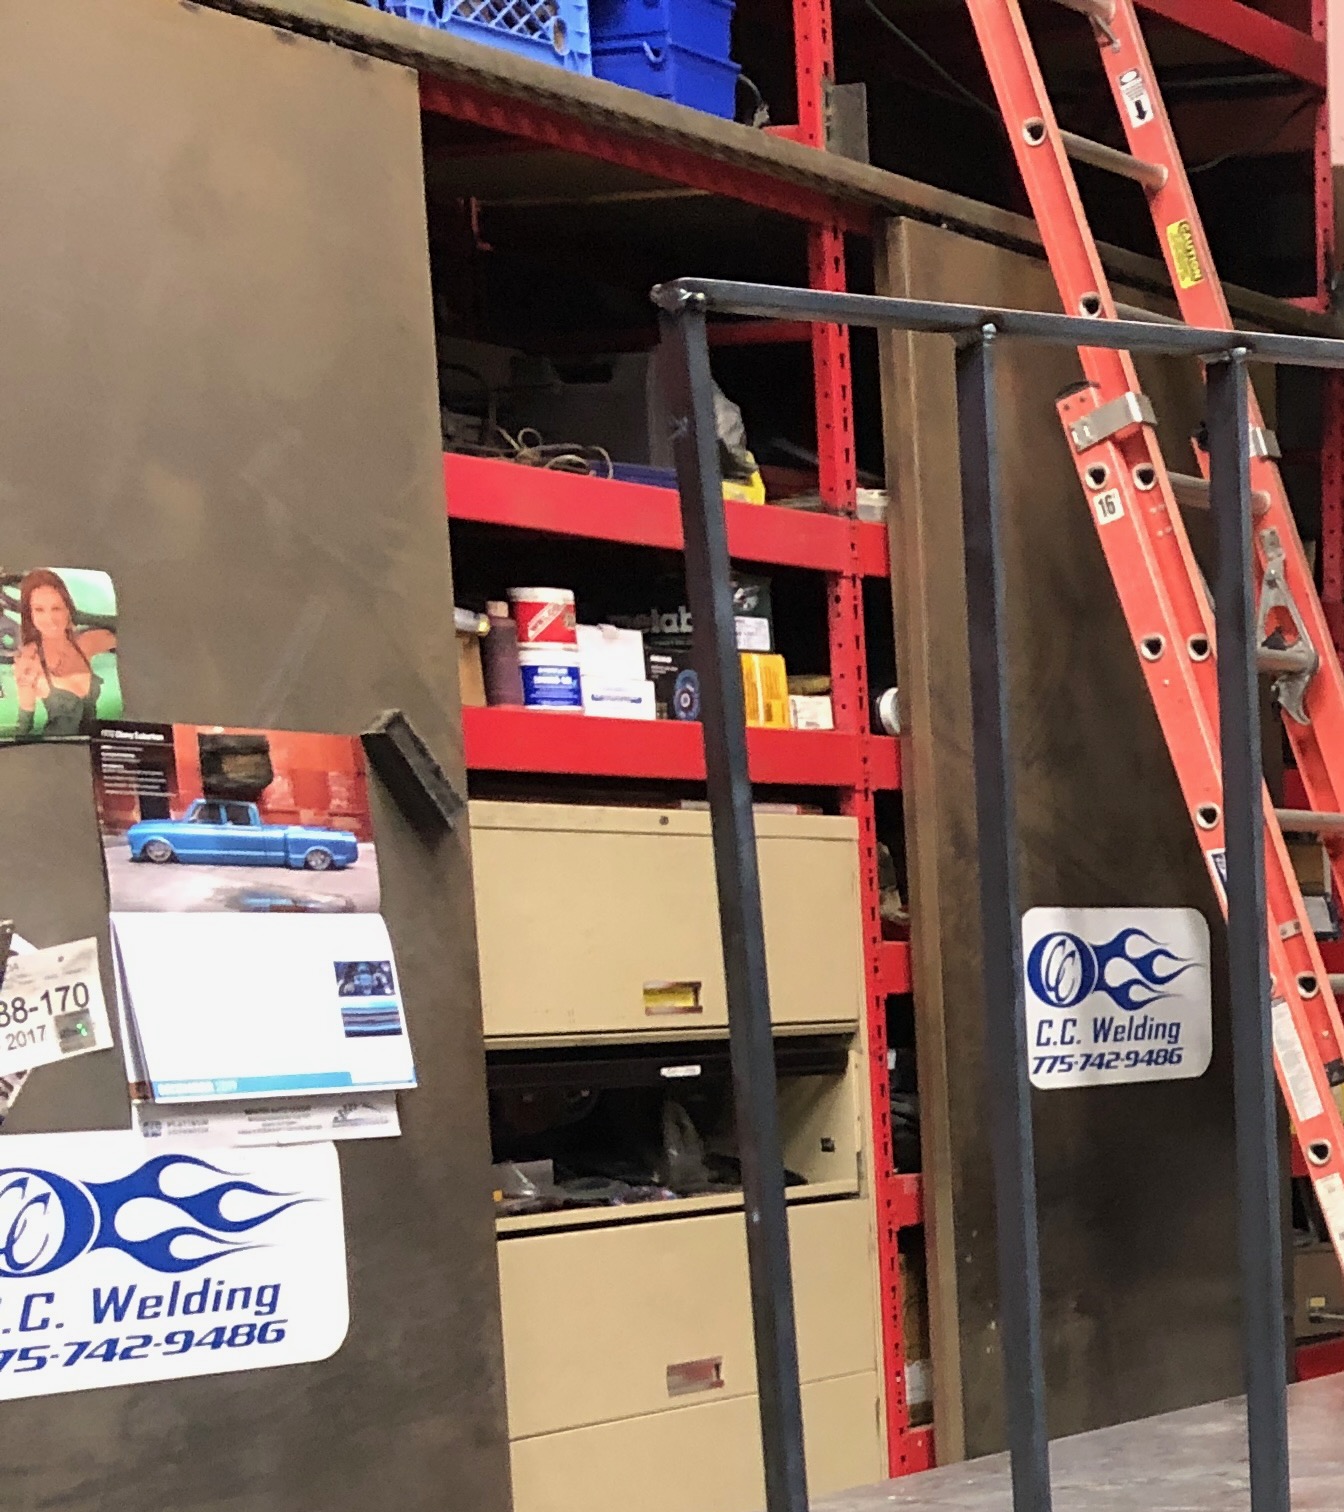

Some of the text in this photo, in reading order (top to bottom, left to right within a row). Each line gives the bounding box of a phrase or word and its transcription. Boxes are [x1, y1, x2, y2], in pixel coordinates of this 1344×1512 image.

[1178, 220, 1203, 282] CAUTION
[5, 1024, 47, 1051] 2017
[1036, 1014, 1182, 1047] C.C. Welding
[1032, 1047, 1184, 1075] 775-742-9486
[0, 1277, 282, 1335] .C. Welding
